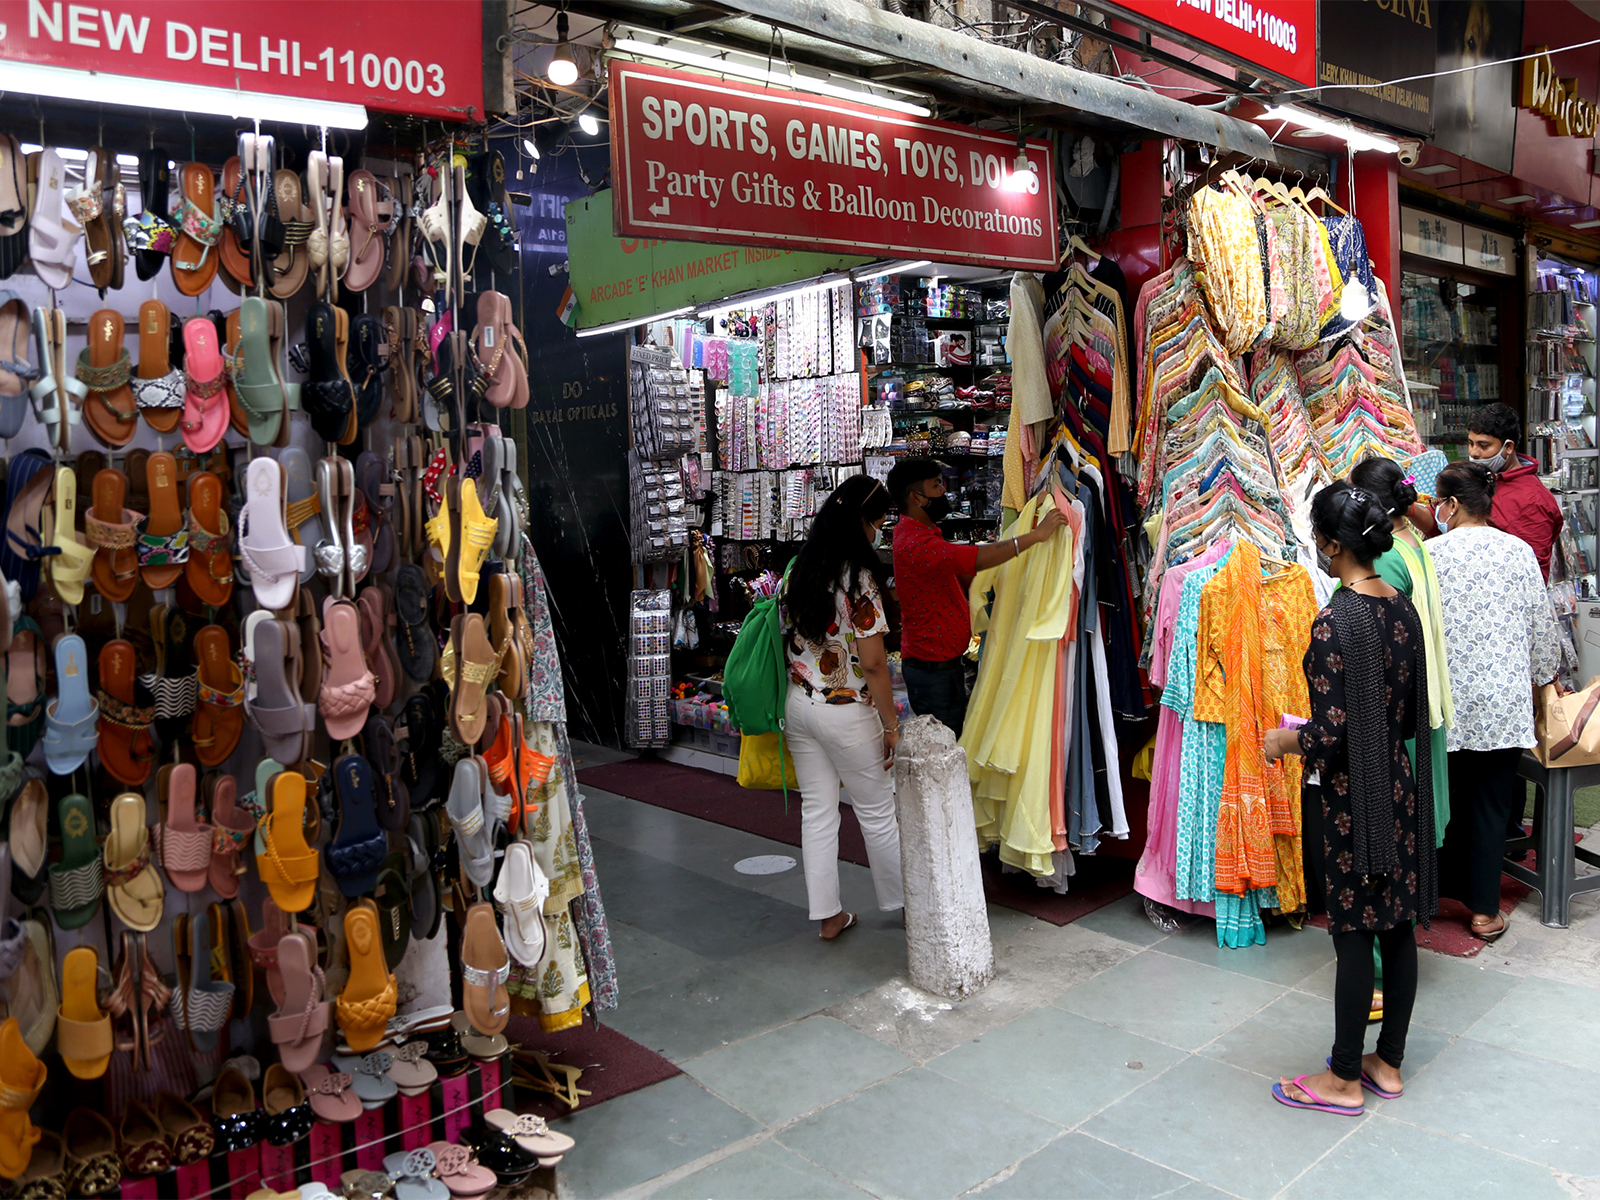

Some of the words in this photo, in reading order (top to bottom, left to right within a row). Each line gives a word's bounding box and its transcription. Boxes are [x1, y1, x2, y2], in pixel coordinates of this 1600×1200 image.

[29, 0, 151, 54] NEW
[166, 21, 446, 97] DELHI-110003
[1215, 0, 1297, 54] DELHI-110003
[641, 95, 777, 162] SPORTS,
[786, 119, 889, 178] GAMES,
[894, 137, 965, 188] TOYS,
[969, 150, 1040, 195] DOLS
[645, 159, 725, 208] Party
[731, 171, 795, 208] Gifts
[802, 179, 823, 211] &
[828, 182, 918, 223] Balloon
[921, 195, 1043, 238] Decorations
[590, 279, 633, 304] ARCADE
[635, 275, 648, 292] 'E'
[651, 264, 684, 289] KHAN
[687, 249, 739, 280] MARKET
[632, 349, 651, 361] FIXED
[651, 353, 671, 365] PRICE
[562, 381, 582, 399] DO
[567, 402, 619, 421] OPTICALS
